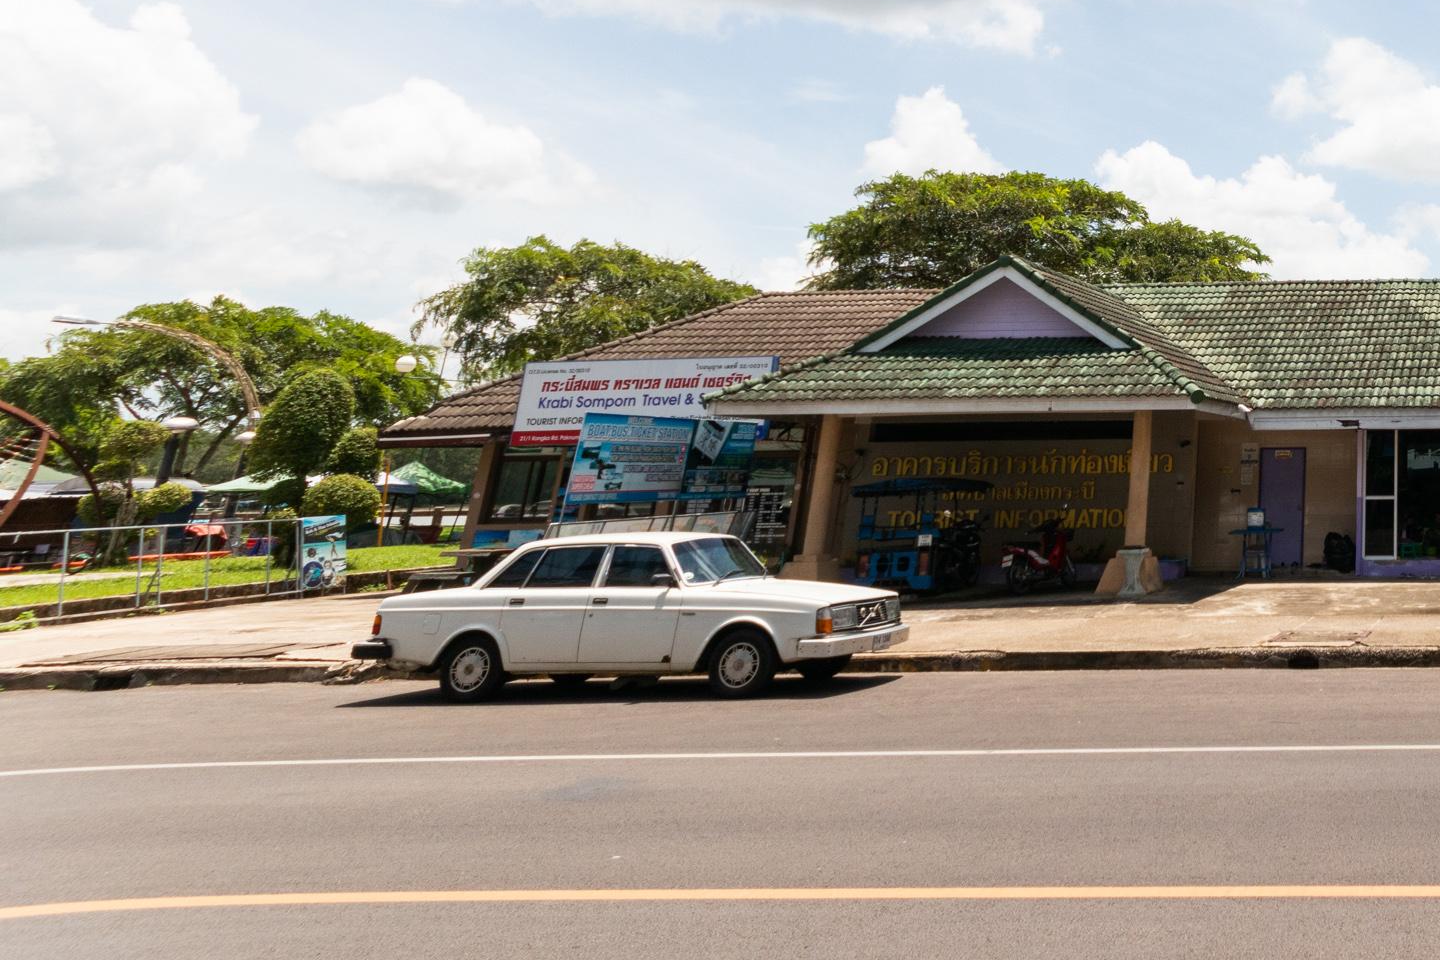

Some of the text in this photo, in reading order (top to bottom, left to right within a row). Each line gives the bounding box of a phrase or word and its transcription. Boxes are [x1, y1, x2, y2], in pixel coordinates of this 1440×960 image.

[538, 397, 574, 409] Krabi
[575, 395, 636, 410] Somporn
[643, 393, 681, 406] Travel
[684, 393, 694, 405] &
[526, 416, 584, 426] TOURIST INFOR
[870, 448, 1174, 477] อาคารบริการนักท่องเยว
[993, 507, 1128, 529] INFORMATIO
